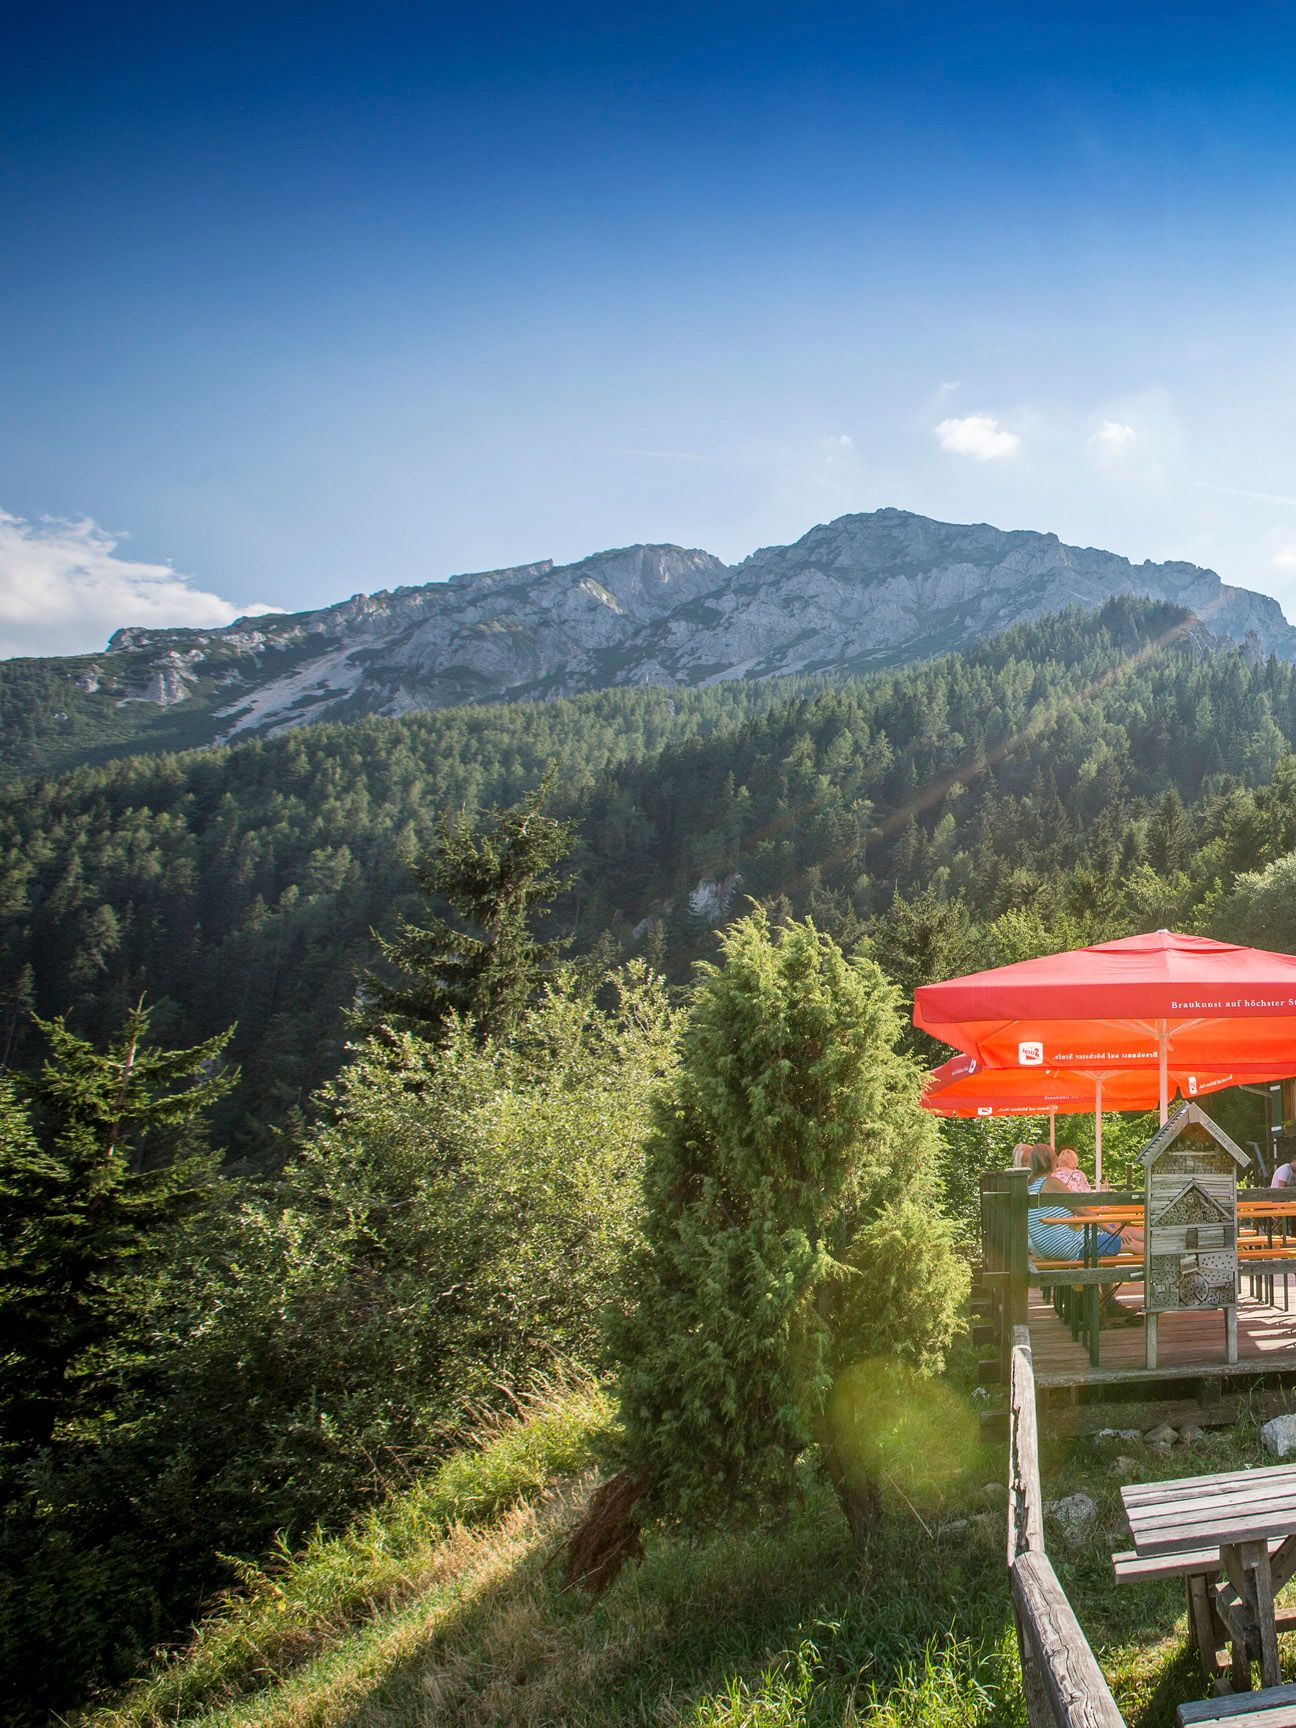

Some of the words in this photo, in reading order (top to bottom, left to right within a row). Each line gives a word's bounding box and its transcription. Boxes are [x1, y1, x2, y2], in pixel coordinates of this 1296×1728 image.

[1171, 1001, 1222, 1009] Braukunst
[1225, 999, 1242, 1008] auf
[1244, 999, 1285, 1007] höchster
